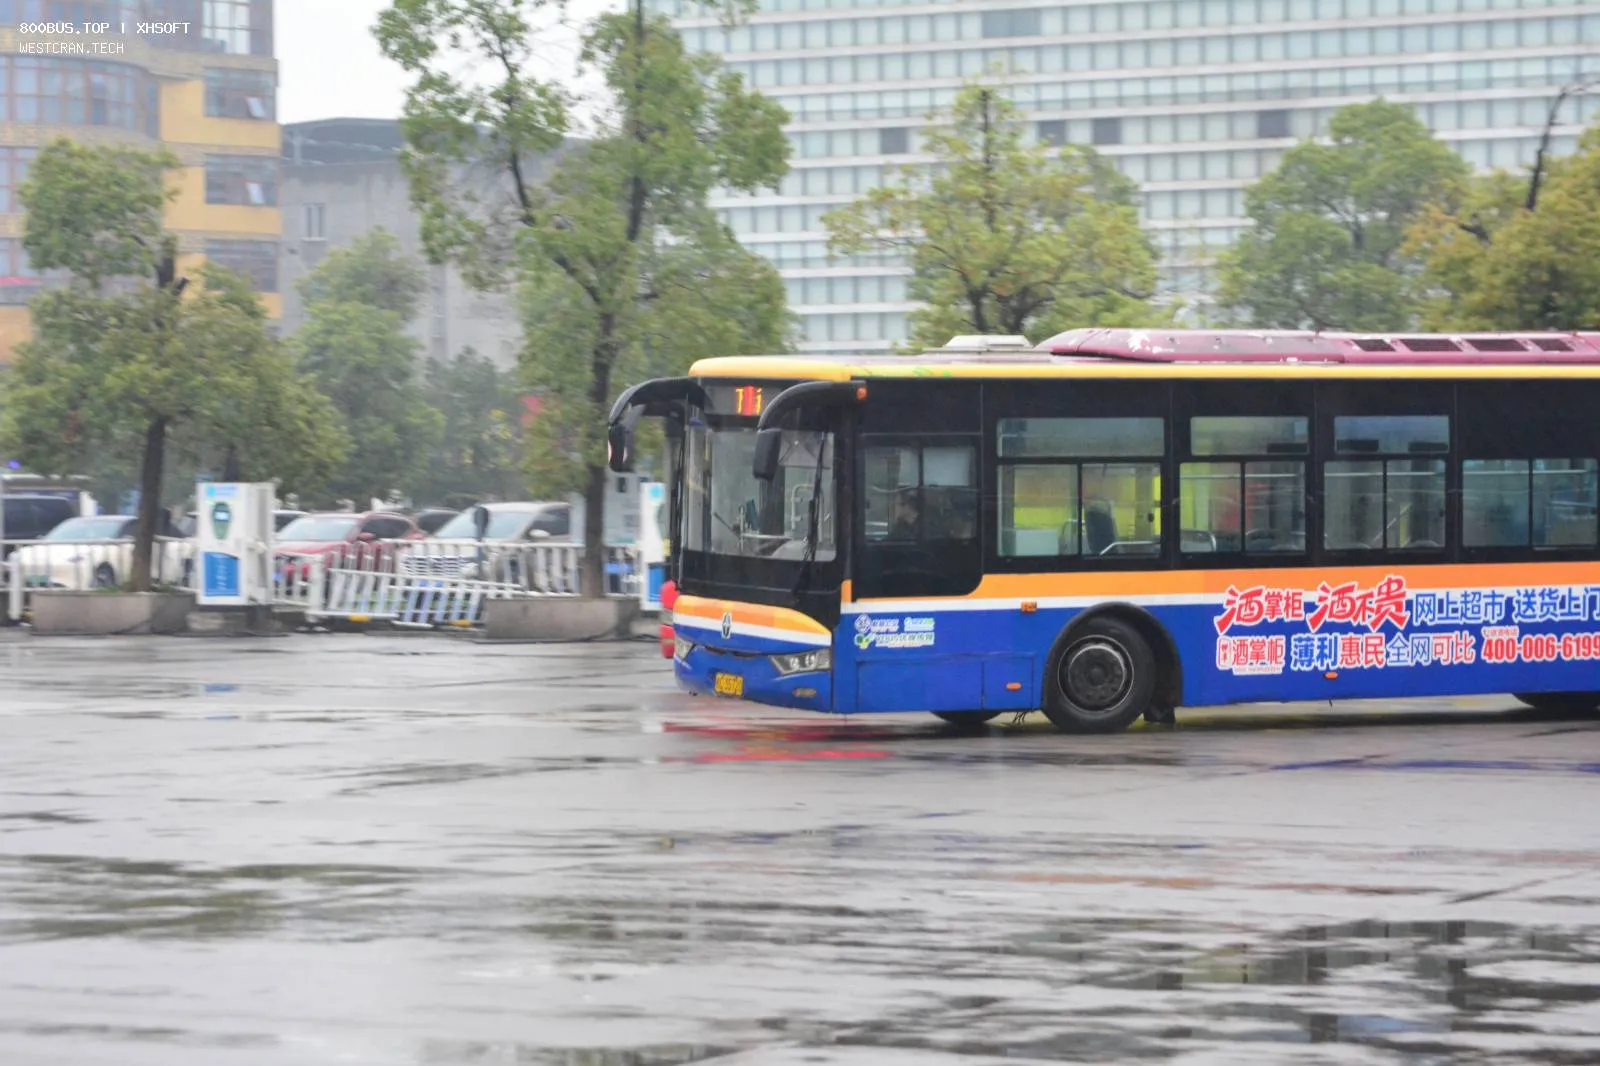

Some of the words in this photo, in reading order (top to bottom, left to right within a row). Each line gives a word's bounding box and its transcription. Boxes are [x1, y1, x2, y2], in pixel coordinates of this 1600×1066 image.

[1216, 587, 1304, 633] 酒掌柜
[1308, 577, 1409, 632] 酒不贵
[1414, 590, 1505, 623] 网上超市
[1515, 587, 1600, 620] 送货上门
[1232, 638, 1284, 666] 酒掌柜
[1291, 633, 1475, 669] 薄利惠民全网可比
[1483, 633, 1600, 661] 400-006-6199
